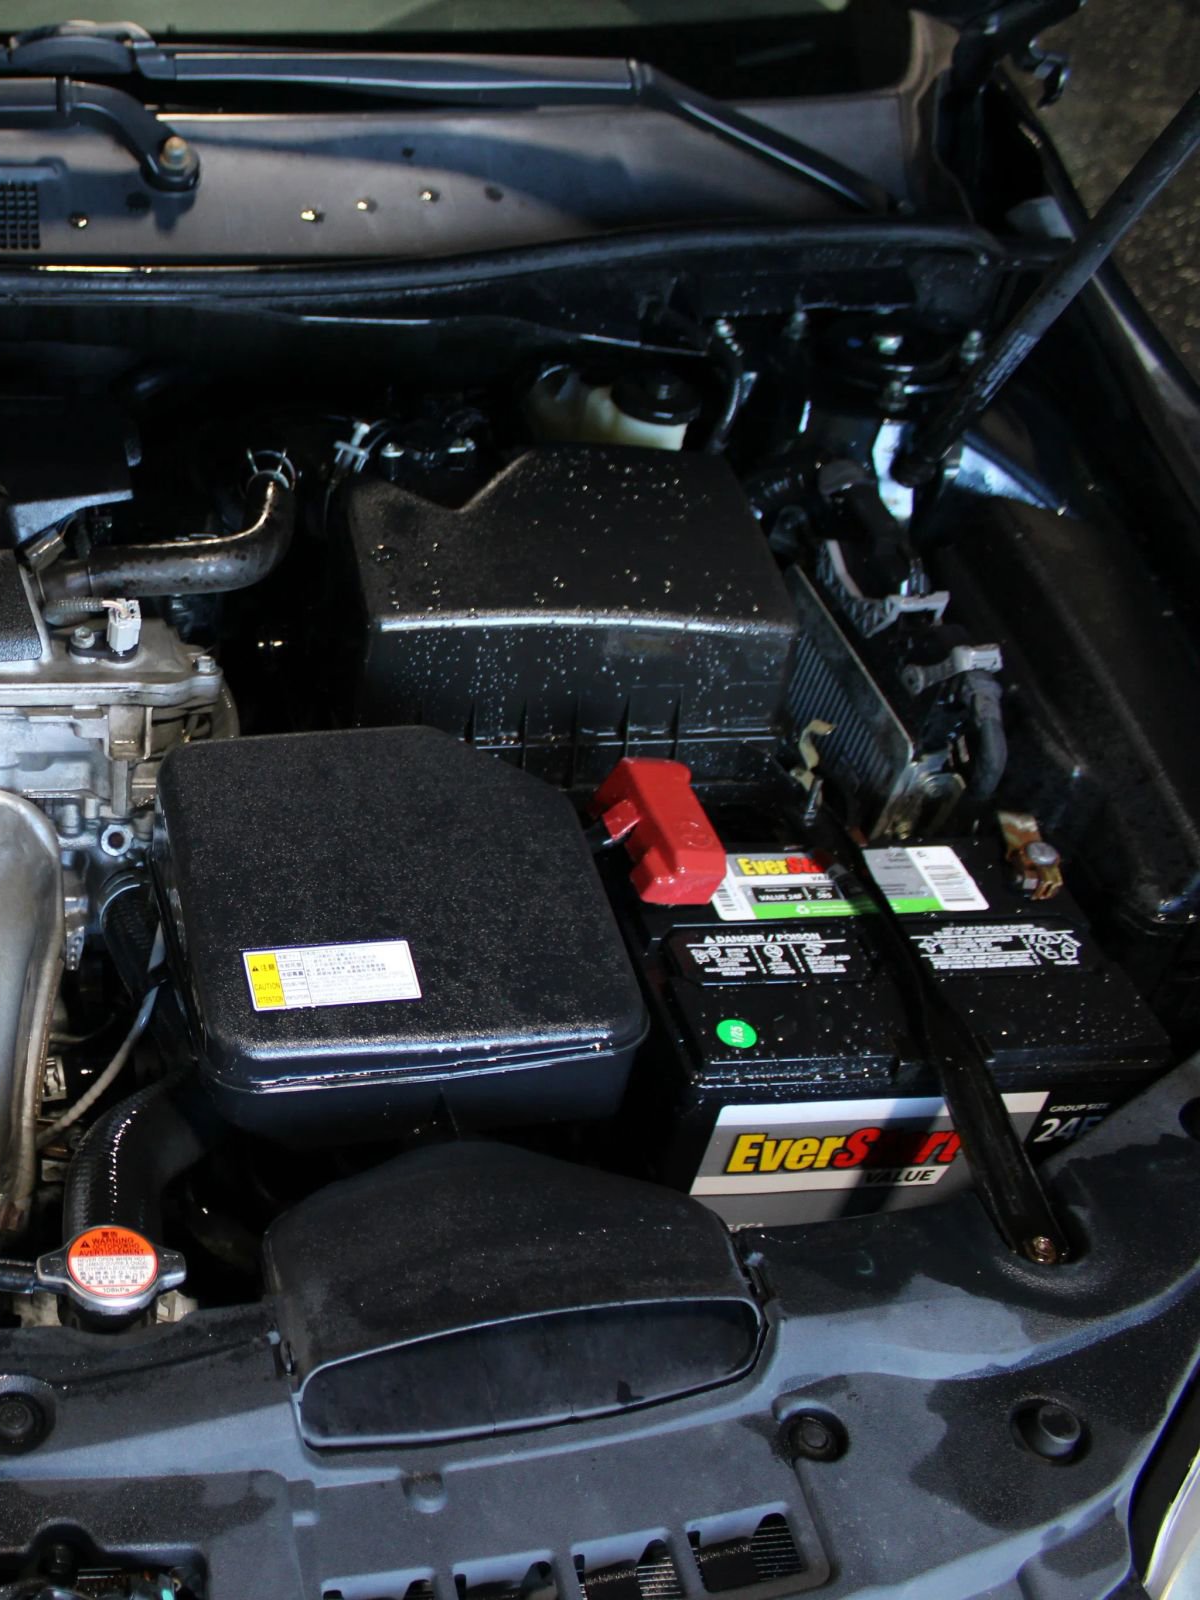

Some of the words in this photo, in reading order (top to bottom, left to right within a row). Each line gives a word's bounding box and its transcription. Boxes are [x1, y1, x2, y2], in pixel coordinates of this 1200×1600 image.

[736, 856, 826, 875] EverSta
[715, 935, 765, 943] DANGER
[776, 932, 821, 941] POISON
[254, 982, 281, 991] CAUTION
[1049, 1104, 1086, 1113] GROUP
[1086, 1102, 1111, 1111] SIZE
[725, 1126, 961, 1173] EverSrt
[865, 1169, 936, 1184] VALUE
